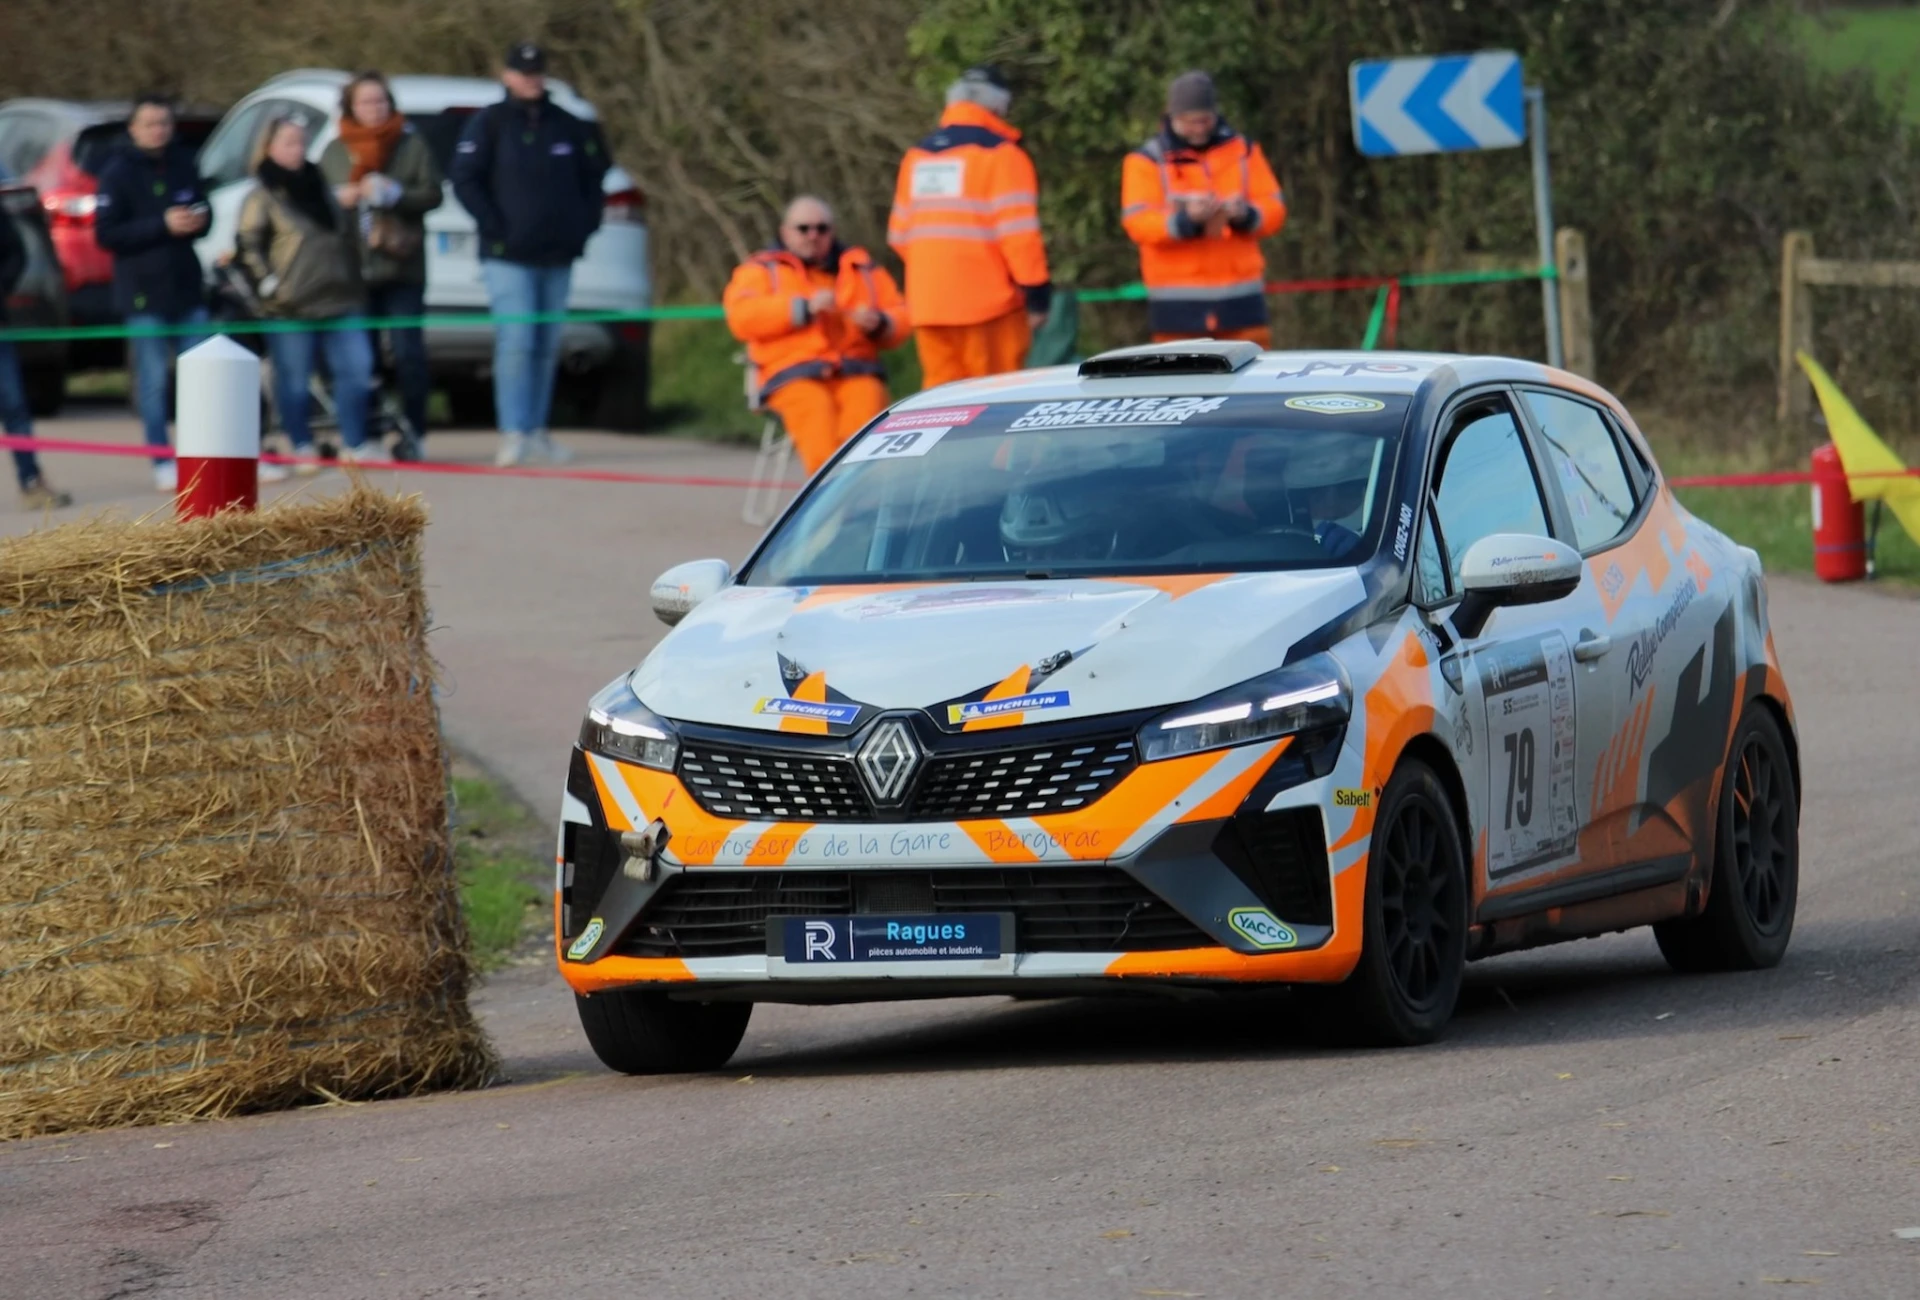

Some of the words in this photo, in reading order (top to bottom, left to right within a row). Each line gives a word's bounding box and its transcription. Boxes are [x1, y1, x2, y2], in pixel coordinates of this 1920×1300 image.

[1025, 397, 1169, 416] RALLYE
[1159, 396, 1229, 413] 24
[1304, 399, 1368, 408] YACCO
[1010, 410, 1195, 429] COMPETITION
[868, 431, 923, 456] 79
[1393, 502, 1413, 562] LOUEZ-MOI
[782, 703, 845, 718] MICHELIN
[984, 695, 1056, 714] MICHELIN
[1504, 727, 1535, 831] 79
[1336, 789, 1371, 807] Sabelt
[684, 835, 810, 858] Carrosserie
[823, 834, 849, 857] de
[859, 833, 879, 854] la
[890, 830, 950, 856] Gare
[985, 829, 1102, 858] Bergerac
[887, 922, 966, 944] Ragues
[1239, 914, 1289, 941] YACCO
[868, 947, 894, 957] pièces
[895, 946, 938, 956] automobile
[939, 947, 948, 955] et
[949, 945, 983, 955] industrie
